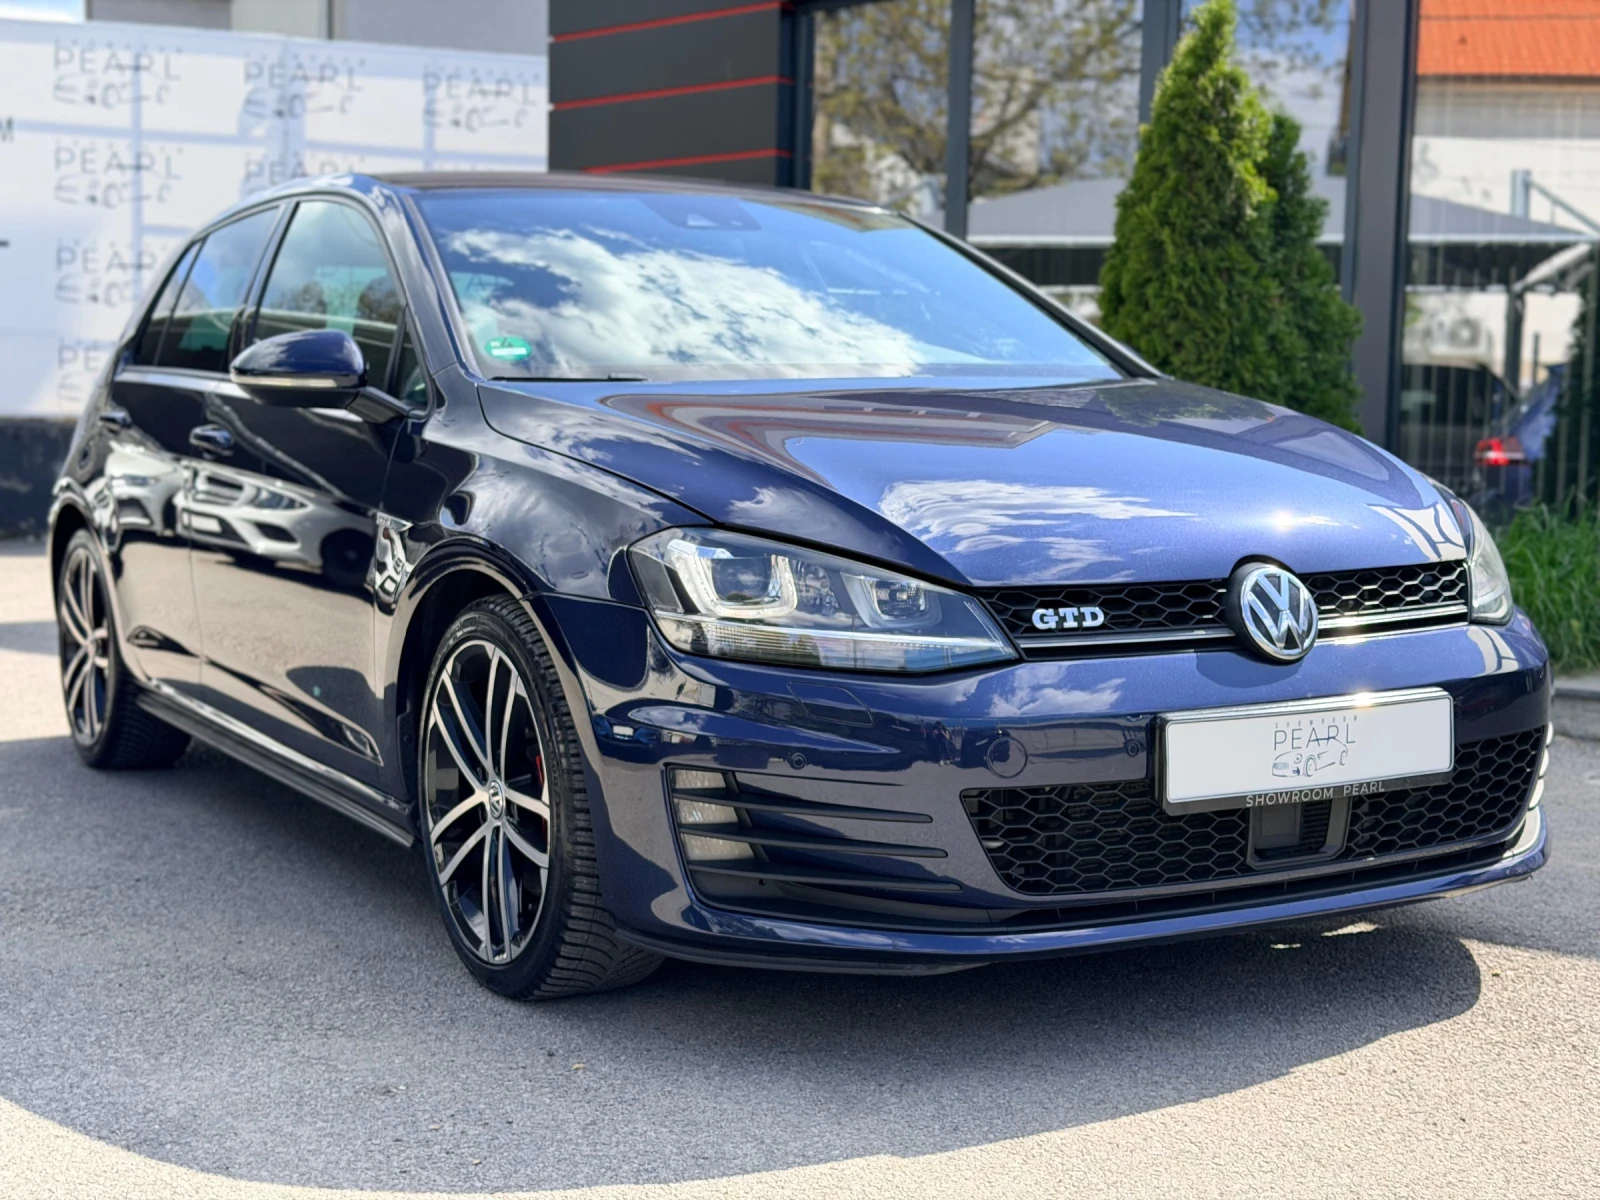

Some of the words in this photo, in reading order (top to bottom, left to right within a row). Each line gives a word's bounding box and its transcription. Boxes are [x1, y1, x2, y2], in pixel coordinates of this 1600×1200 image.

[53, 46, 182, 82] PEARL
[242, 61, 363, 92] PEARL
[422, 72, 537, 106] PEARL
[54, 146, 182, 181] PEARL
[55, 245, 157, 275] PEAR
[1031, 606, 1105, 630] GTD
[1274, 723, 1356, 751] PEARL
[1246, 787, 1334, 807] SHOWROOM
[1343, 781, 1385, 797] PEARL
